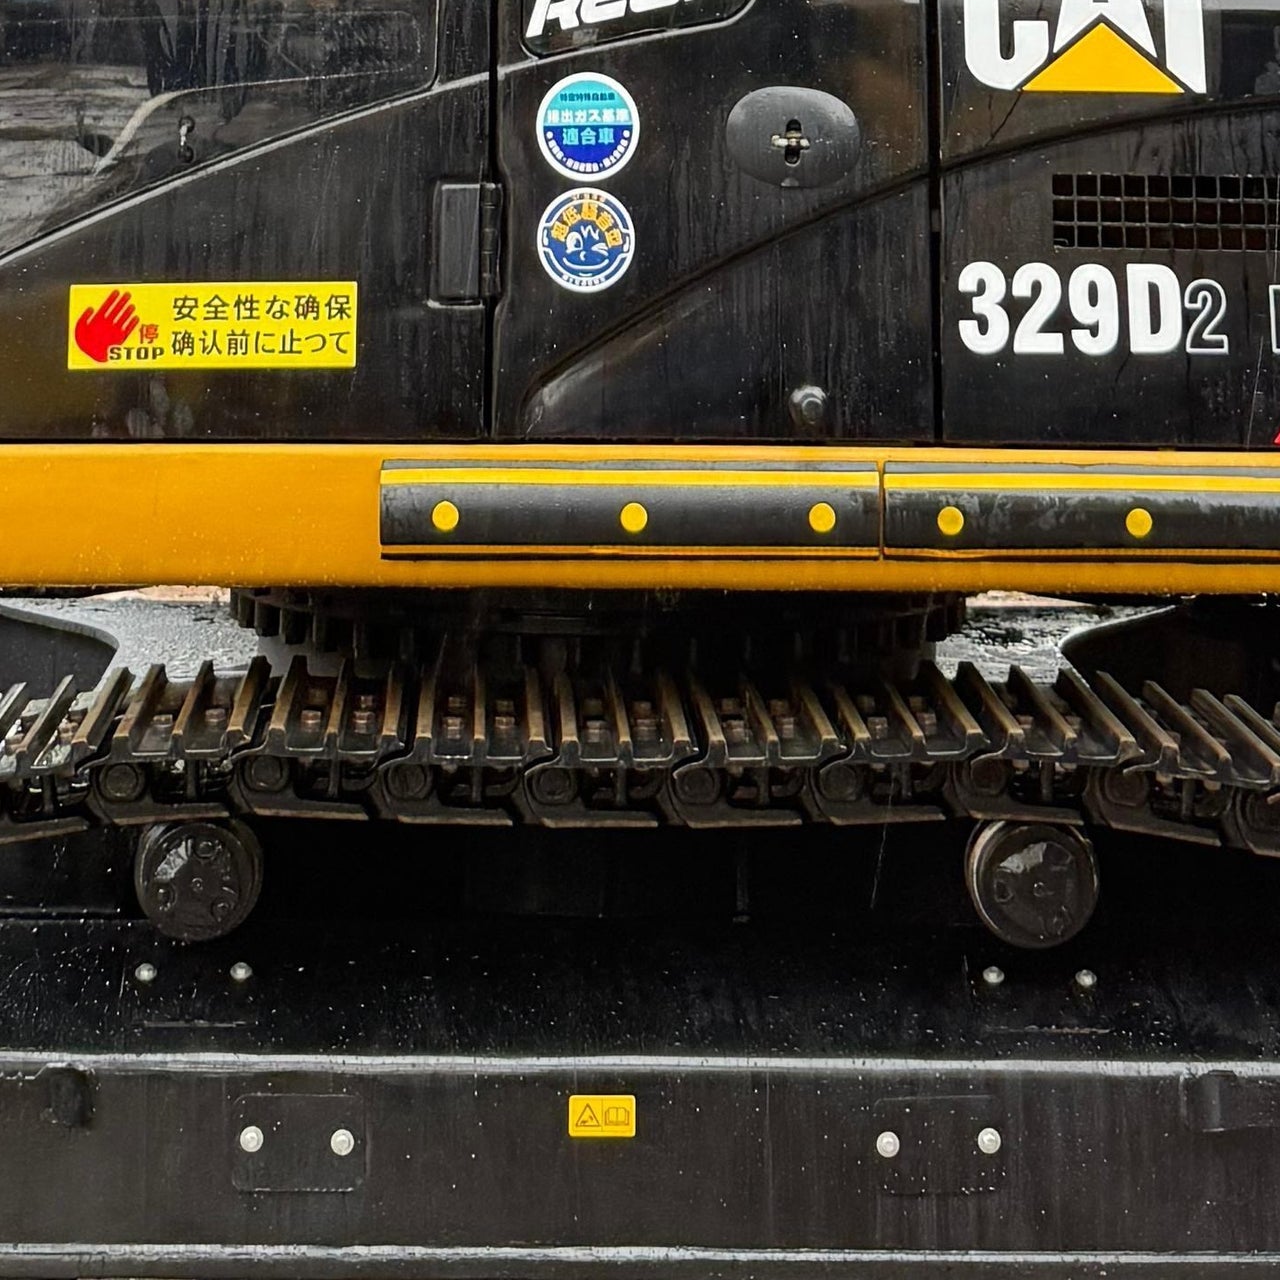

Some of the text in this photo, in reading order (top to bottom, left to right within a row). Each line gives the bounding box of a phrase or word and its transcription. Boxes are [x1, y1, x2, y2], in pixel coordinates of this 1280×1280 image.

[172, 294, 352, 321] 安全性な确保
[109, 346, 164, 361] STOP
